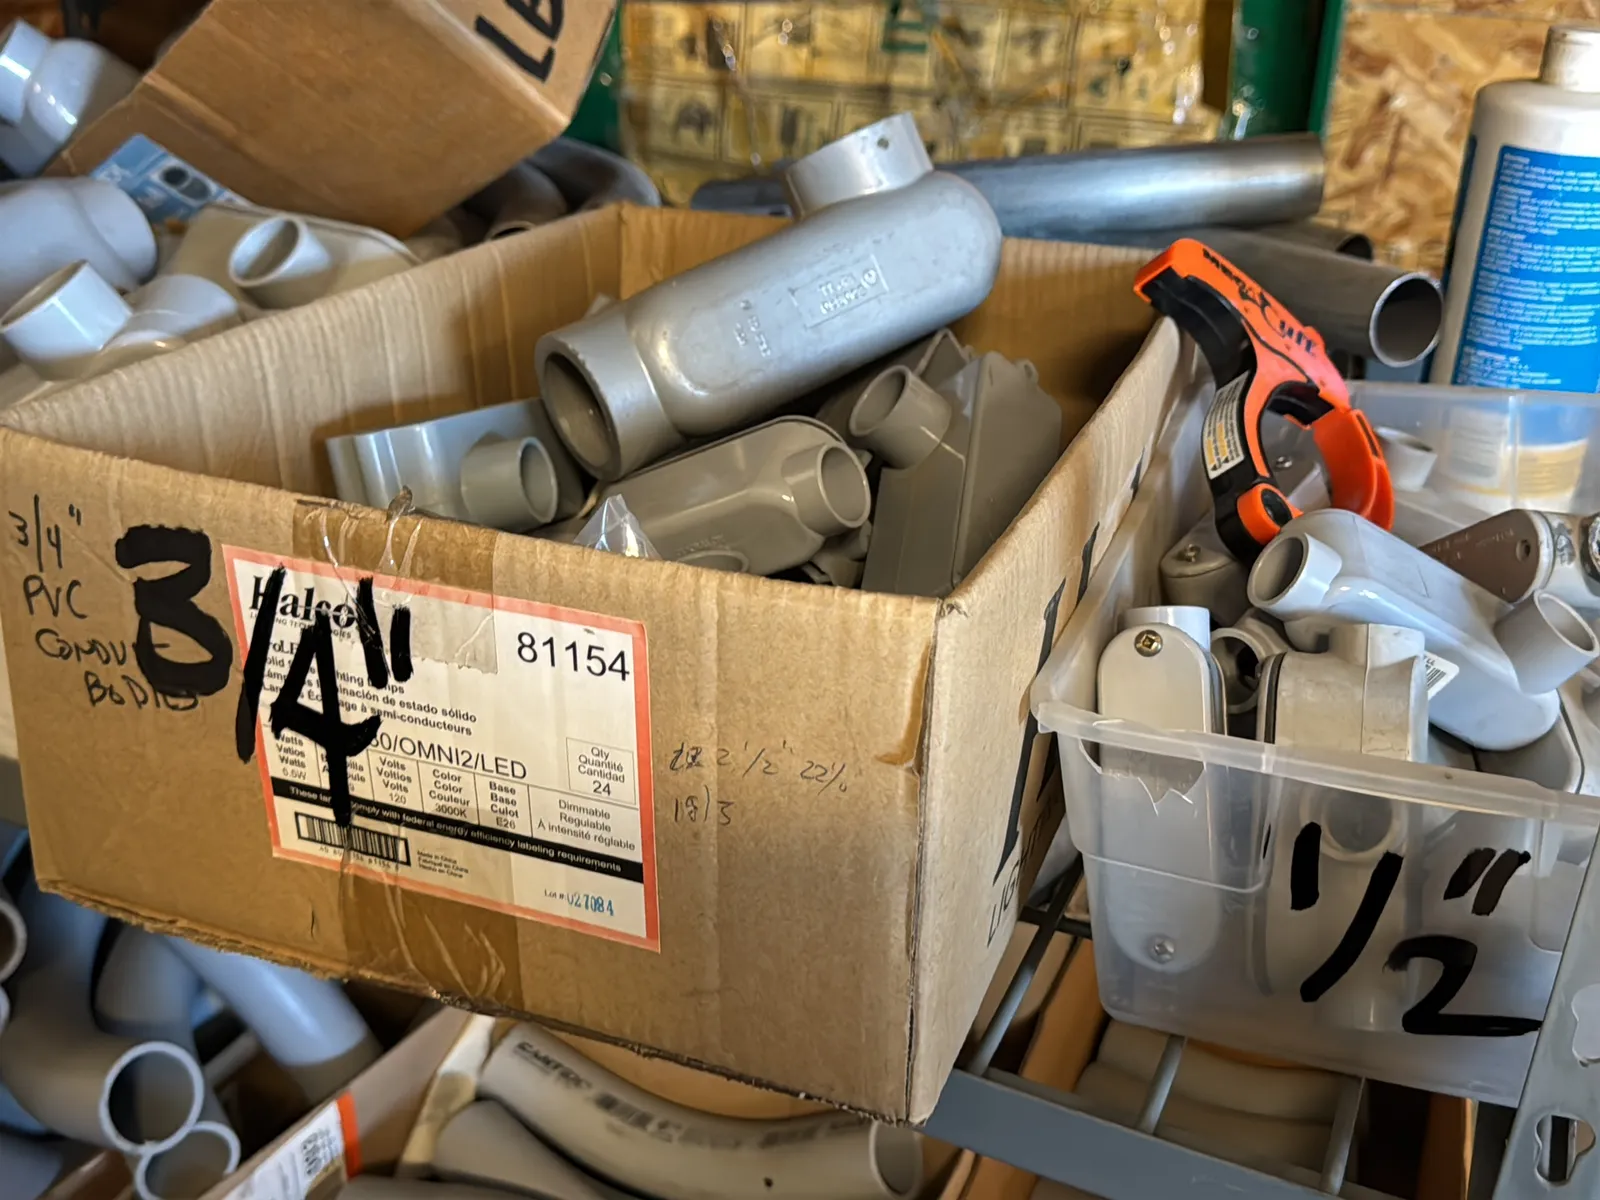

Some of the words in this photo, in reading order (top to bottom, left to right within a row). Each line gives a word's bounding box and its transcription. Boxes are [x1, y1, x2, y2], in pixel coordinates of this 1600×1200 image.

[24, 575, 88, 618] PVC
[266, 656, 285, 668] olid
[517, 631, 630, 682] 81154
[84, 670, 199, 711] BODI
[382, 696, 396, 707] de
[400, 700, 438, 716] estado
[441, 706, 477, 723] sólido
[370, 709, 473, 737] semi-conducteurs
[276, 743, 305, 758] Vatios
[591, 747, 610, 761] Qty
[279, 755, 306, 768] Watts
[379, 756, 407, 771] Volts
[578, 754, 624, 773] Quantité
[376, 767, 413, 783] Voltios
[432, 768, 462, 783] Color
[577, 765, 626, 784] Cantidad
[382, 779, 409, 794] Volts
[433, 780, 463, 794] Color
[489, 781, 516, 796] Base
[592, 780, 612, 797] 24
[388, 792, 407, 805] 120
[428, 790, 471, 807] Couleur
[490, 792, 517, 807] Base
[435, 802, 468, 818] 3000K
[490, 803, 519, 819] Culot
[558, 799, 611, 820] Dimmable
[290, 785, 318, 800] These
[381, 807, 401, 820] with
[402, 812, 435, 828] federal
[436, 821, 469, 837] energy
[470, 829, 516, 849] efficiency
[517, 840, 555, 859] labeling
[557, 850, 622, 872] requirements
[559, 811, 612, 833] Regulable
[549, 823, 591, 841] intensité
[593, 832, 636, 851] réglable
[544, 888, 558, 898] Lot
[1290, 821, 1544, 1037] 1/2"
